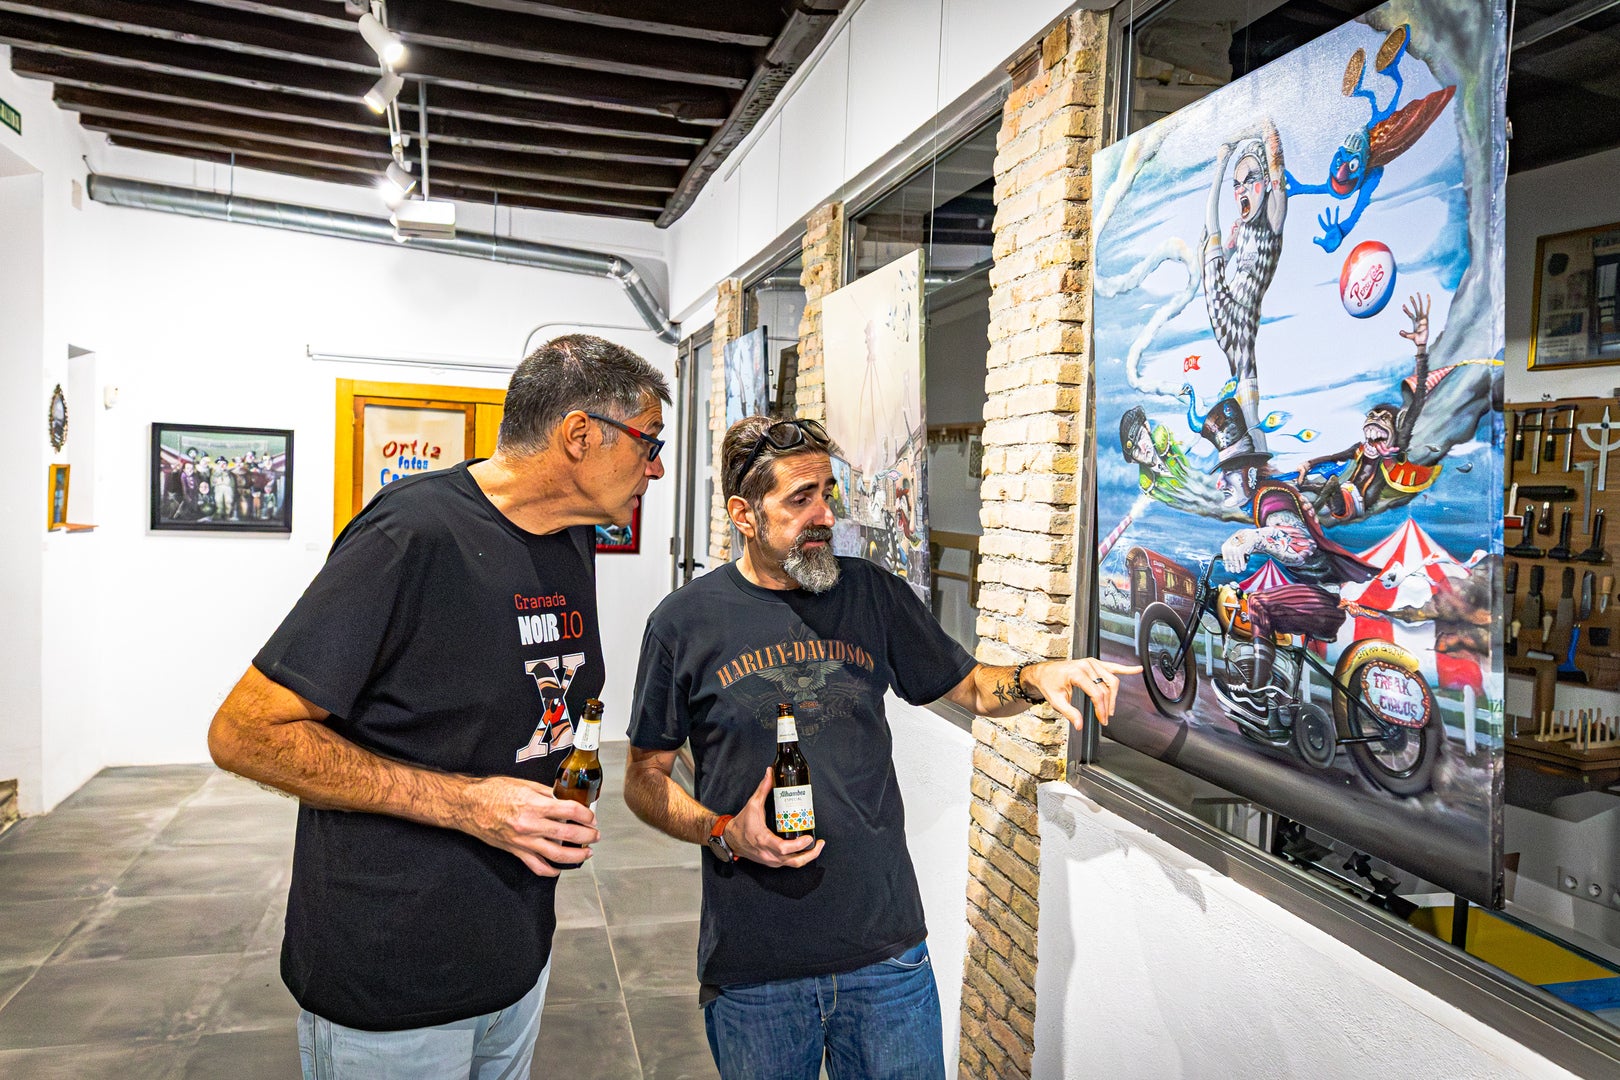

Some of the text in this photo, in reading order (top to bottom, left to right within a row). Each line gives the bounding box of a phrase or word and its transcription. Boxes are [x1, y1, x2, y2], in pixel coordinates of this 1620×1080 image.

[514, 592, 567, 610] Granada
[517, 610, 584, 646] NOIR 10
[716, 639, 874, 688] HARLEY-DAVIDSON
[1373, 672, 1412, 697] FREAK
